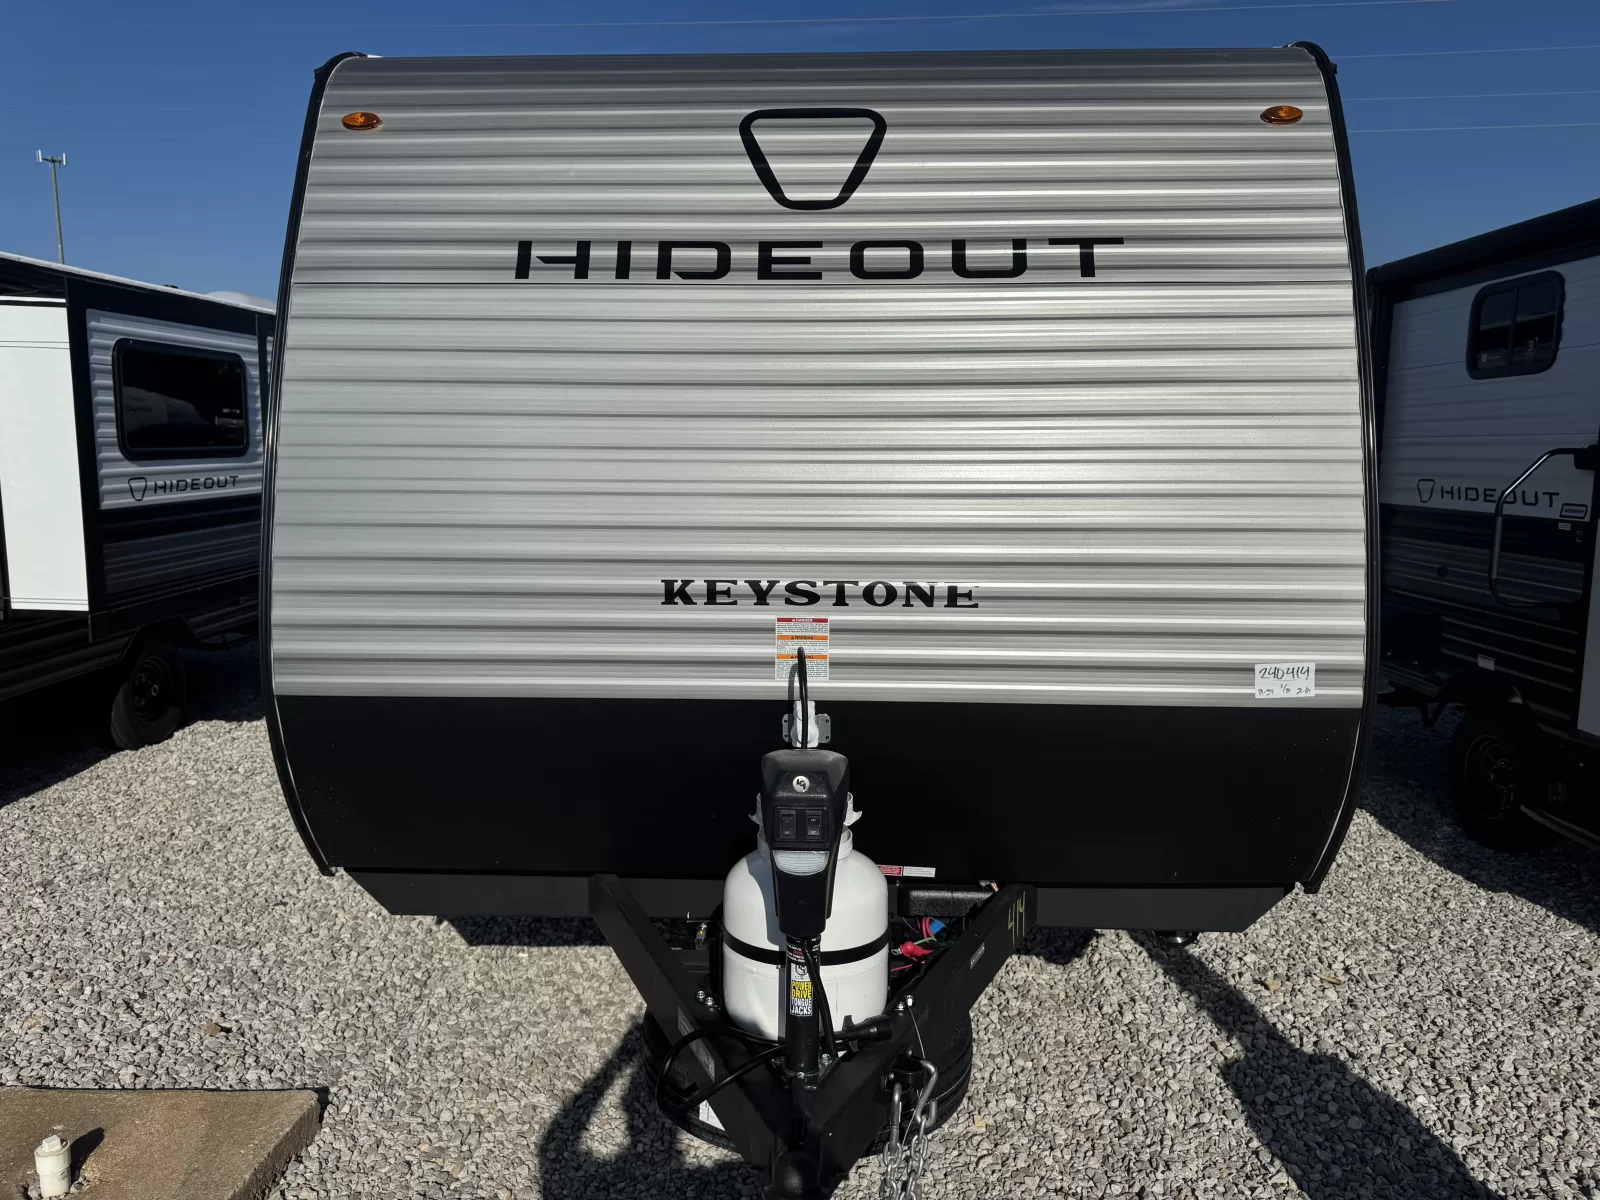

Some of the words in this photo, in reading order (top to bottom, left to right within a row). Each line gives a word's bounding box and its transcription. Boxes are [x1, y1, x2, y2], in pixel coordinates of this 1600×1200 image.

[514, 238, 1125, 281] HIDEOUT
[153, 475, 239, 494] HIDEOUT
[1440, 485, 1560, 508] HIDEOUT
[660, 579, 980, 608] KEYSTONE
[791, 980, 812, 990] POWER
[791, 989, 812, 999] DRIVE
[791, 998, 812, 1007] TONGUE
[791, 1006, 812, 1015] JACKS
